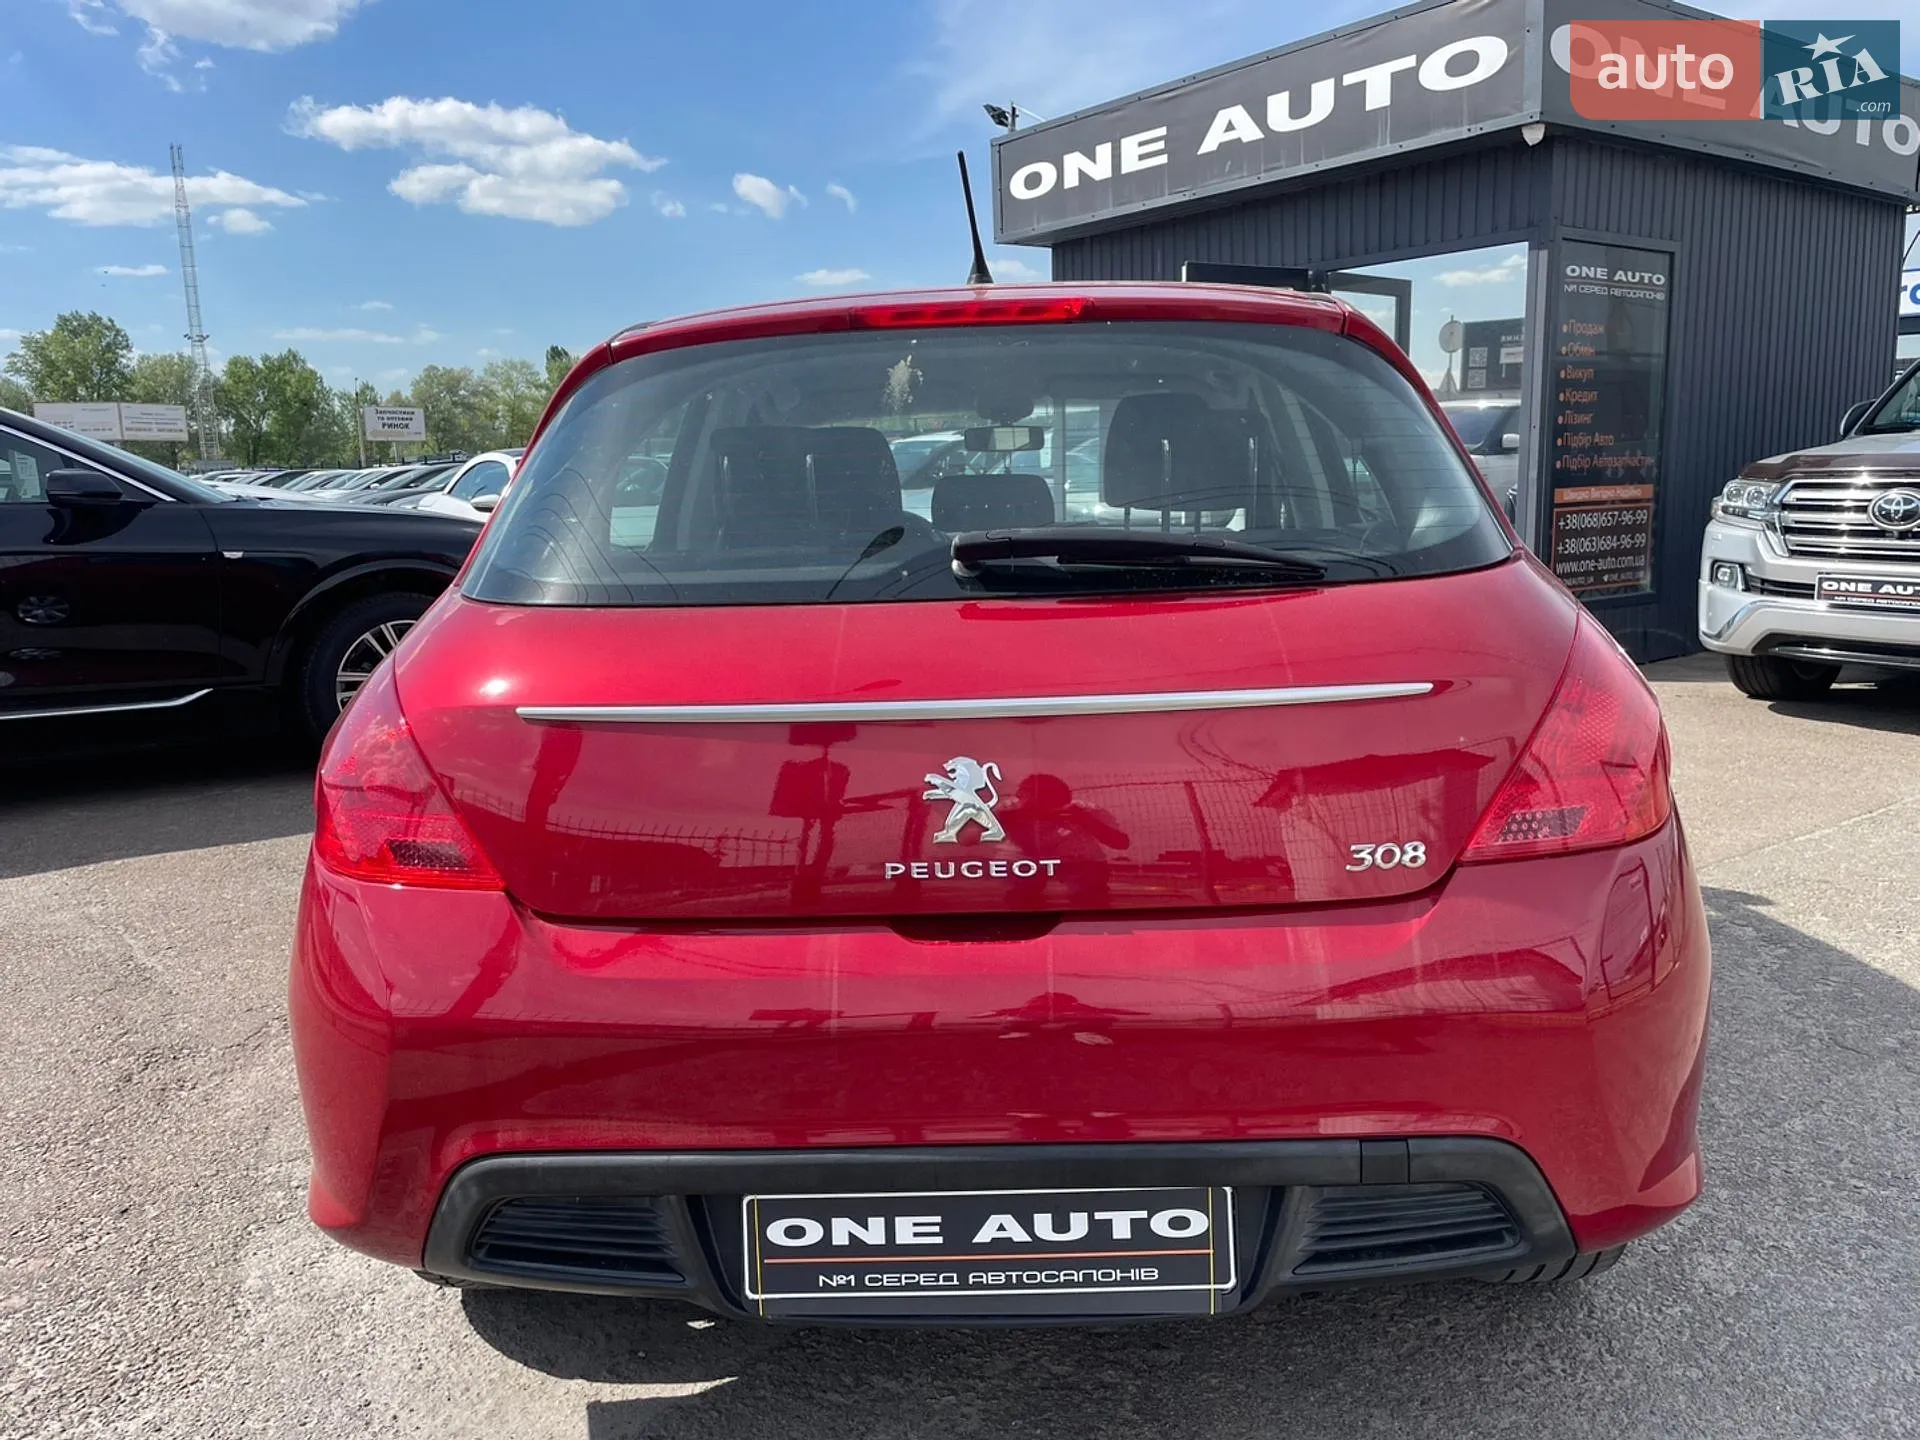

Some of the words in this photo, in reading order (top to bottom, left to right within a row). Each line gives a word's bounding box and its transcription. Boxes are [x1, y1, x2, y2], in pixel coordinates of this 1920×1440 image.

[1550, 23, 1726, 110] ONE
[1009, 126, 1169, 201] ONE
[1197, 35, 1509, 156] AUTO
[1566, 265, 1608, 280] ONE
[1613, 270, 1666, 285] AUTO
[1566, 364, 1595, 382] Викуп
[381, 422, 410, 430] РИНОК
[1563, 432, 1593, 449] Підбір
[1593, 432, 1615, 447] Авто
[1558, 509, 1648, 530] +38(068)657-96-99
[1557, 533, 1647, 555] +38(063)684-96-99
[1556, 555, 1645, 575] www.one-auto.com.ua
[1821, 581, 1873, 593] ONE
[1345, 841, 1428, 872] 308
[884, 859, 1062, 880] PEUGEOT
[765, 1215, 944, 1247] ONE
[971, 1208, 1210, 1244] AUTO
[818, 1273, 855, 1288] №1
[864, 1272, 960, 1287] СЕРЕД
[968, 1267, 1160, 1285] АВТОСАЛОНІВ
